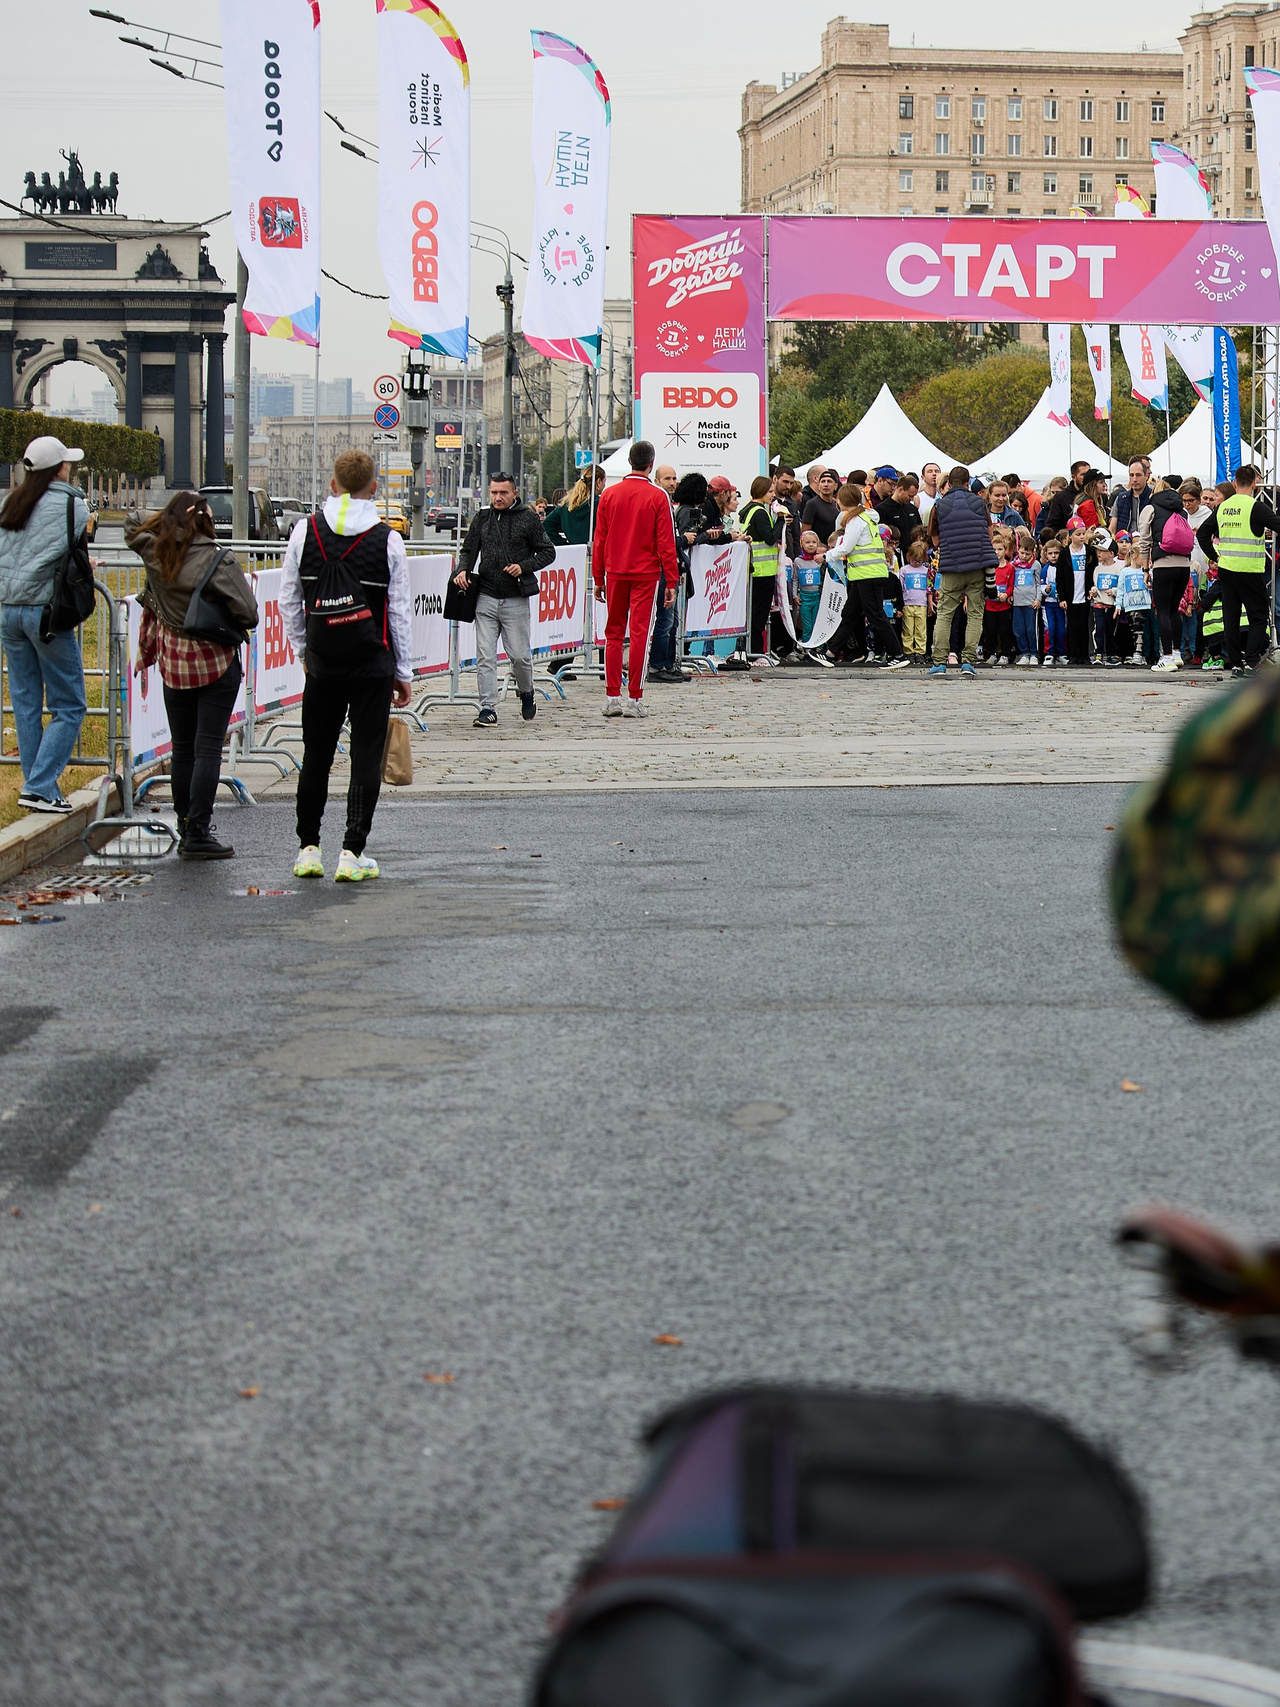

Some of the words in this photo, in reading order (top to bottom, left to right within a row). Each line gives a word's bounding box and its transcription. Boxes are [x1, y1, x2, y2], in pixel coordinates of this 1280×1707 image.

[1196, 243, 1246, 265] ДОБРЫЕ
[885, 241, 1117, 299] СТАРТ
[1194, 279, 1247, 303] ПРОЕКТЫ
[657, 320, 688, 335] ДОБРЫЕ
[714, 327, 745, 338] ДЕТИ
[655, 342, 690, 358] ПРОЕКТЫ
[712, 338, 747, 348] НАШИ
[1219, 335, 1228, 363] ВОДА
[379, 382, 394, 394] 80
[663, 387, 738, 409] BBDO
[1222, 390, 1230, 422] МОЖЕТ
[697, 421, 731, 430] Media
[697, 430, 737, 439] Instinct
[697, 441, 730, 451] Group
[421, 593, 443, 617] Tooba
[538, 568, 577, 623] BBDO
[265, 599, 295, 671] BBD
